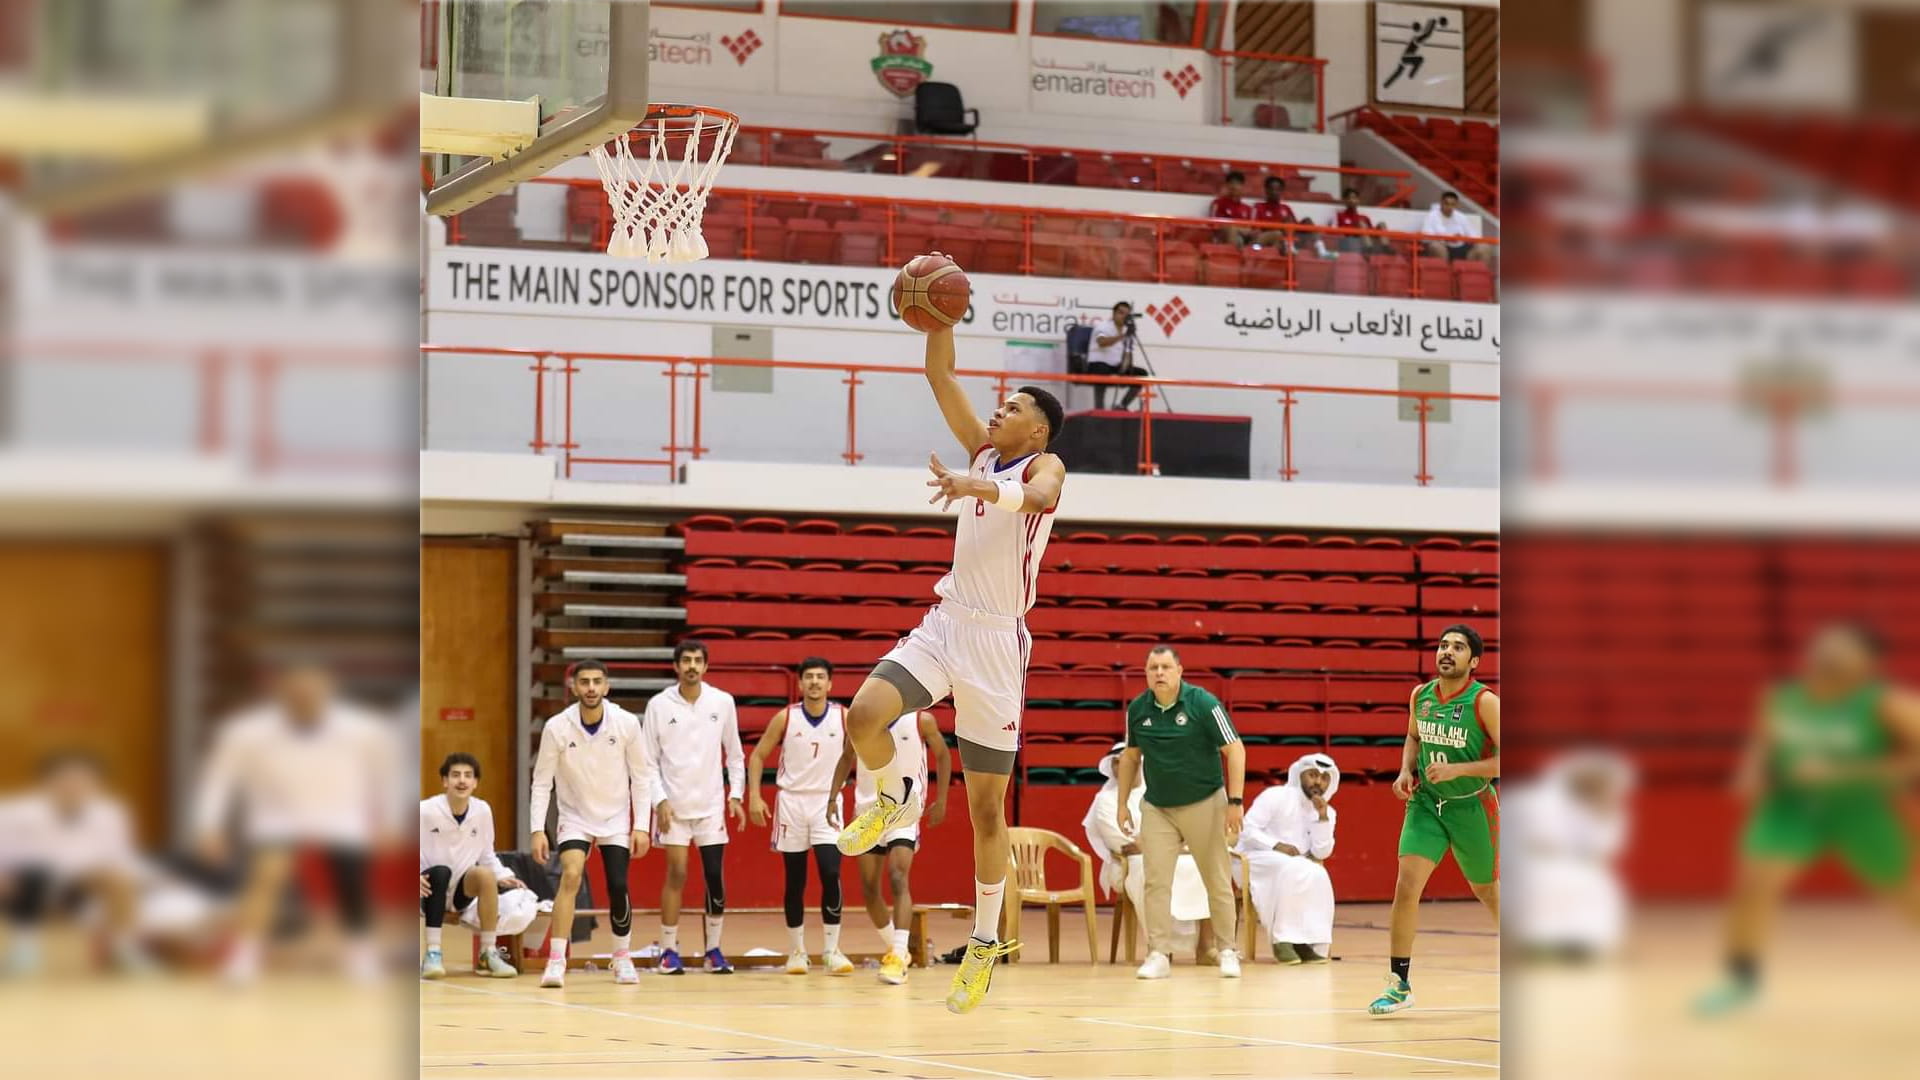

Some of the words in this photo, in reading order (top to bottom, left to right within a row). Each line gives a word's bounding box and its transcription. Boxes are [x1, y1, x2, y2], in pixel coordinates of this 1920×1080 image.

[1031, 72, 1156, 98] emaratech
[447, 261, 501, 301] THE
[510, 265, 580, 305] MAIN
[588, 268, 714, 312] SPONSOR
[724, 275, 774, 314] FOR
[782, 278, 879, 319] SPORTS
[1224, 303, 1321, 338] الرياضية
[1330, 308, 1412, 342] الألعاب
[1420, 316, 1483, 352] لقطاع
[1448, 725, 1468, 741] AHLI
[811, 741, 819, 759] 7
[780, 823, 787, 839] 7
